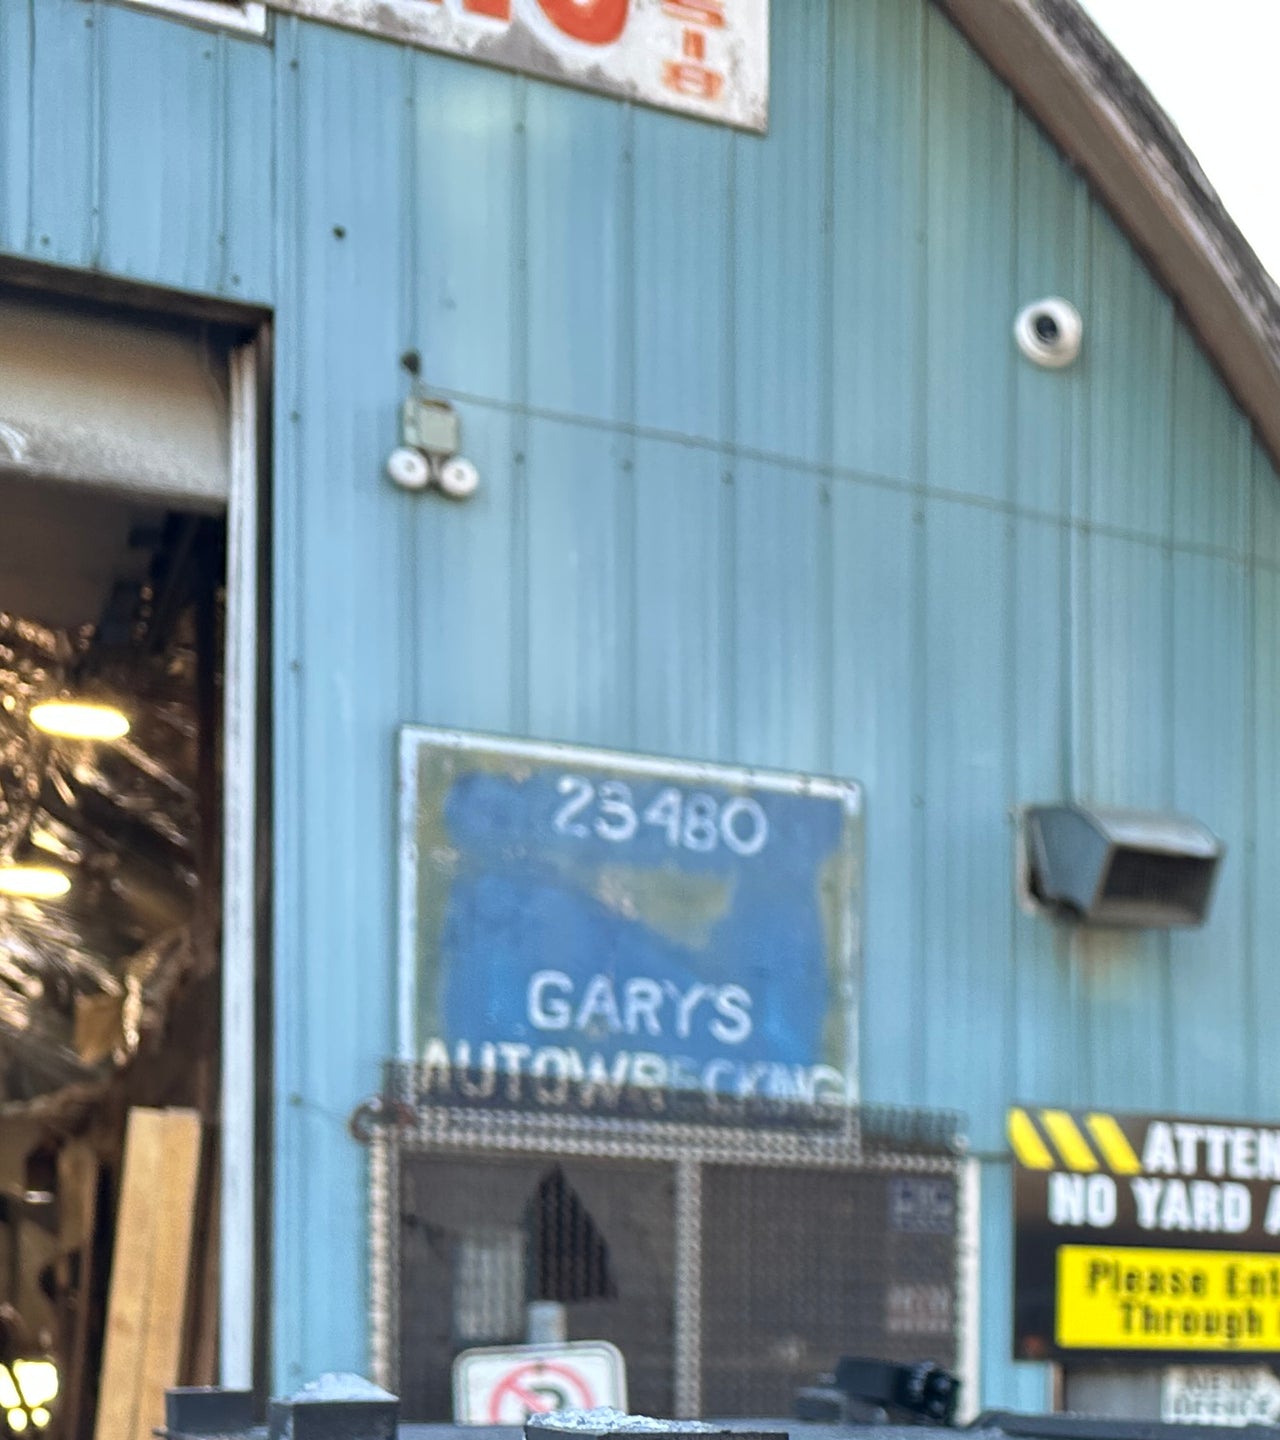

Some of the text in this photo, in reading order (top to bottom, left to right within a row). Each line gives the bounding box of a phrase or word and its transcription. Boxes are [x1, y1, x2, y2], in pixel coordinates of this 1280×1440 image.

[552, 773, 769, 856] 23480
[526, 969, 754, 1045] GARYS
[1046, 1172, 1117, 1228] NO
[1131, 1177, 1251, 1234] YARD
[1087, 1256, 1208, 1297] Please
[1120, 1301, 1263, 1342] Through
